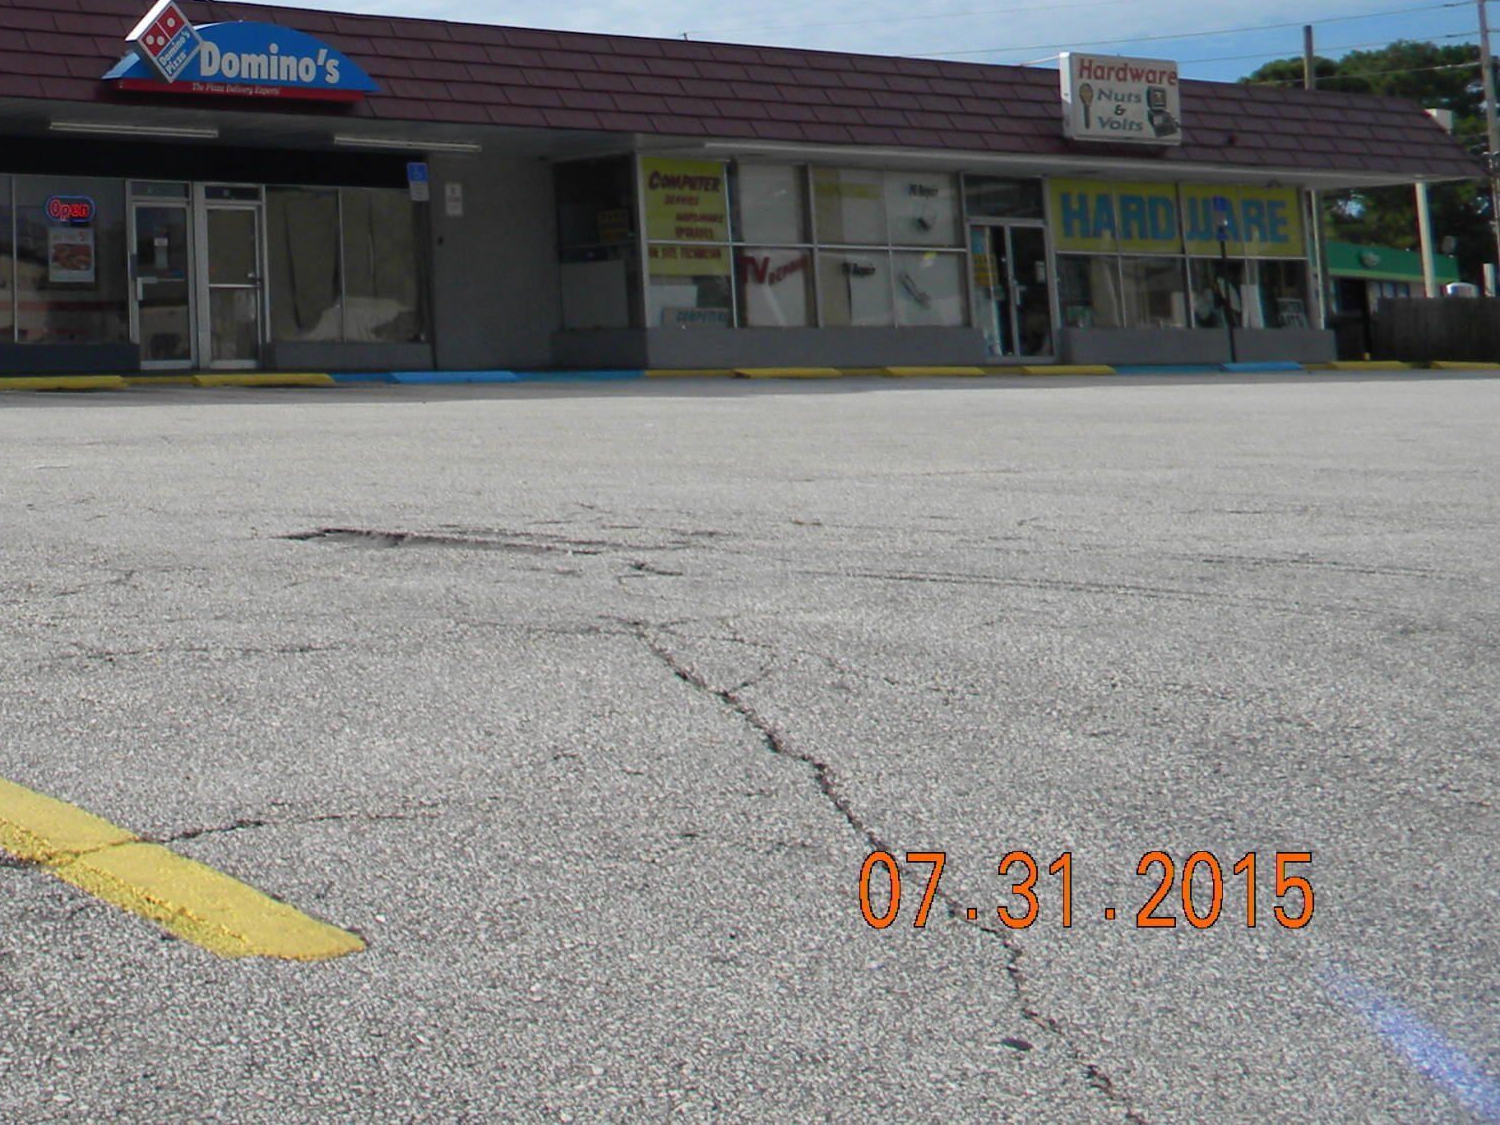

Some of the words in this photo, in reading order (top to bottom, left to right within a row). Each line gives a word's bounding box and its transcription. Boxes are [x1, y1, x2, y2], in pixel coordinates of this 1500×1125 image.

[159, 31, 190, 66] Domino's
[166, 50, 187, 75] Pizza
[200, 41, 340, 84] Domino's
[1078, 58, 1178, 86] Hardware
[1097, 88, 1142, 103] Nuts
[1114, 105, 1126, 116] &
[1098, 117, 1143, 132] Volts
[50, 198, 90, 221] Open
[1060, 192, 1290, 243] HARDWARE
